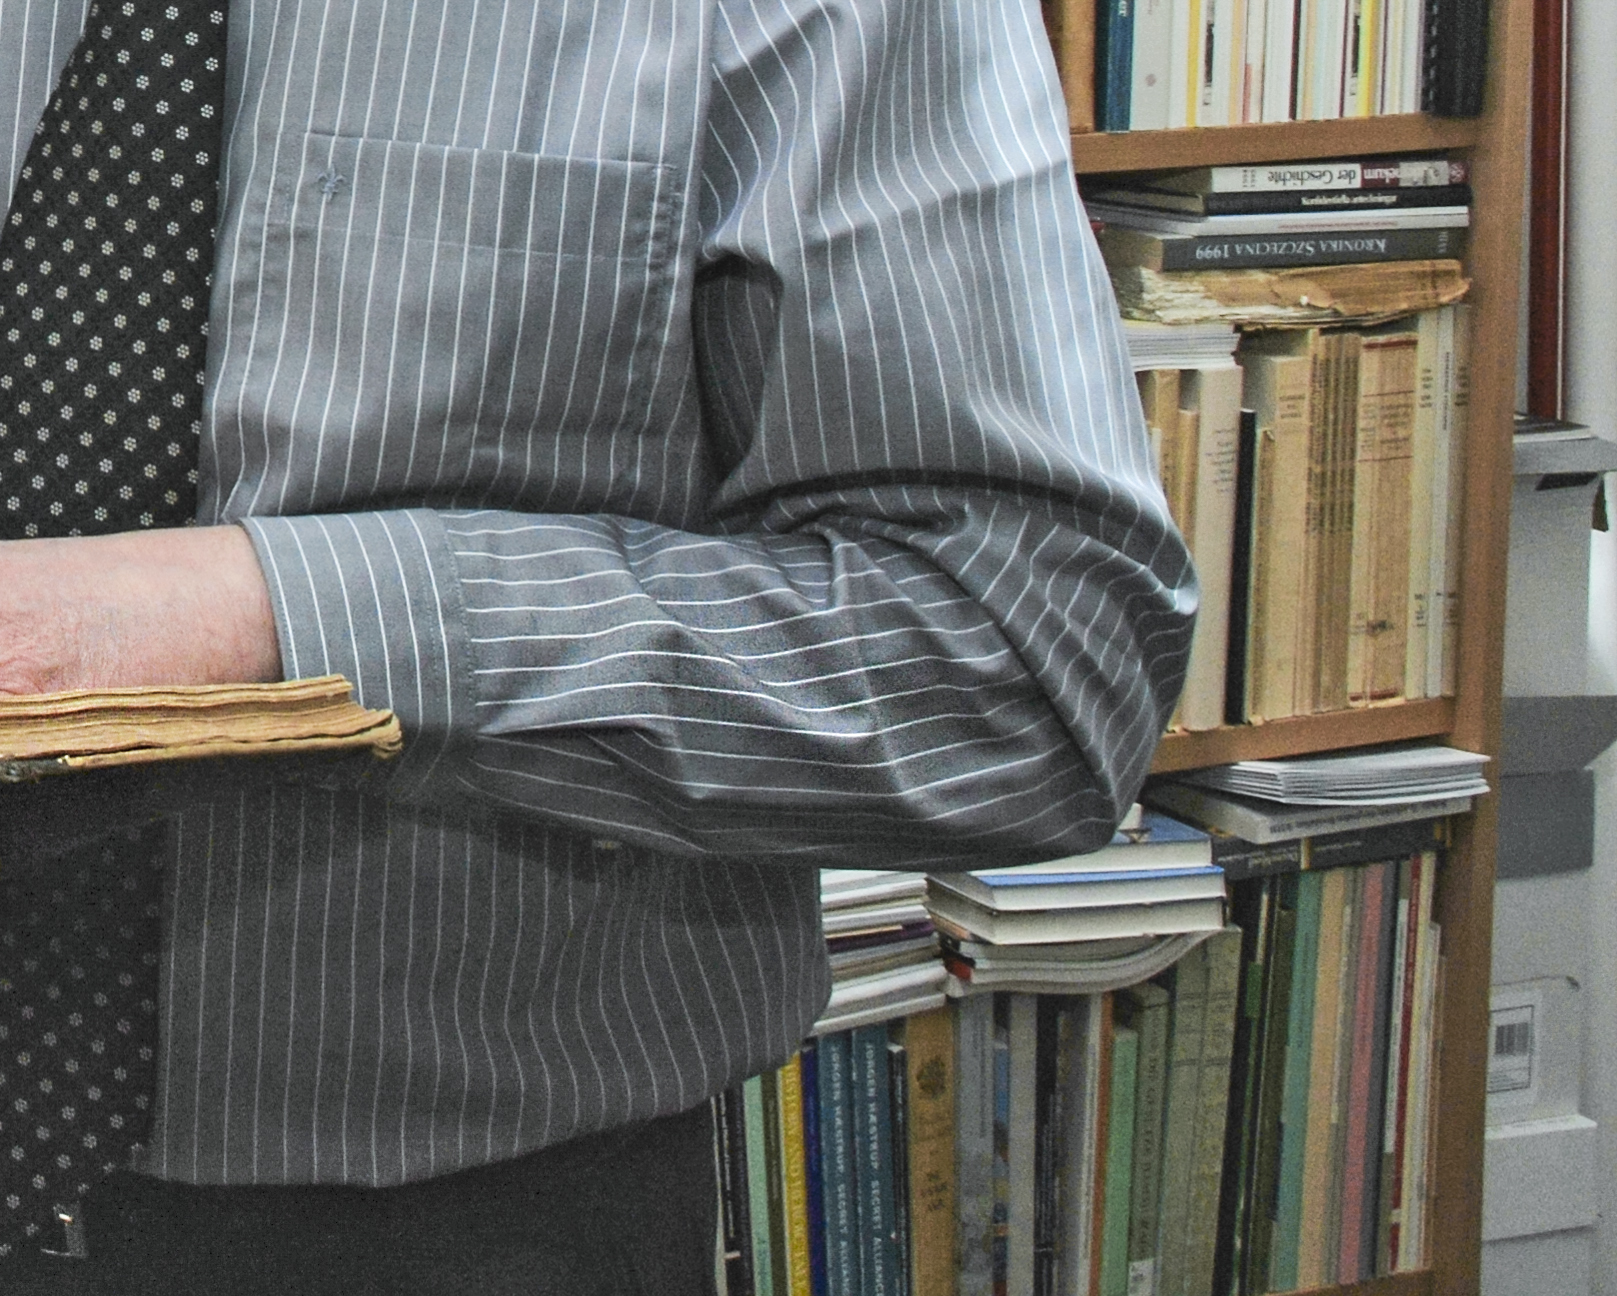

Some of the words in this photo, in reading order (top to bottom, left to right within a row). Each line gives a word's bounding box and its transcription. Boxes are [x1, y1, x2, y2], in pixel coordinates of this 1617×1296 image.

[1266, 169, 1333, 189] Geschichte
[1337, 169, 1356, 185] der
[1195, 243, 1230, 260] 1999
[1233, 240, 1315, 257] SZCZECINA
[1319, 238, 1386, 254] KRONIKA
[837, 1183, 848, 1235] SECRET
[870, 1180, 883, 1231] SECRET
